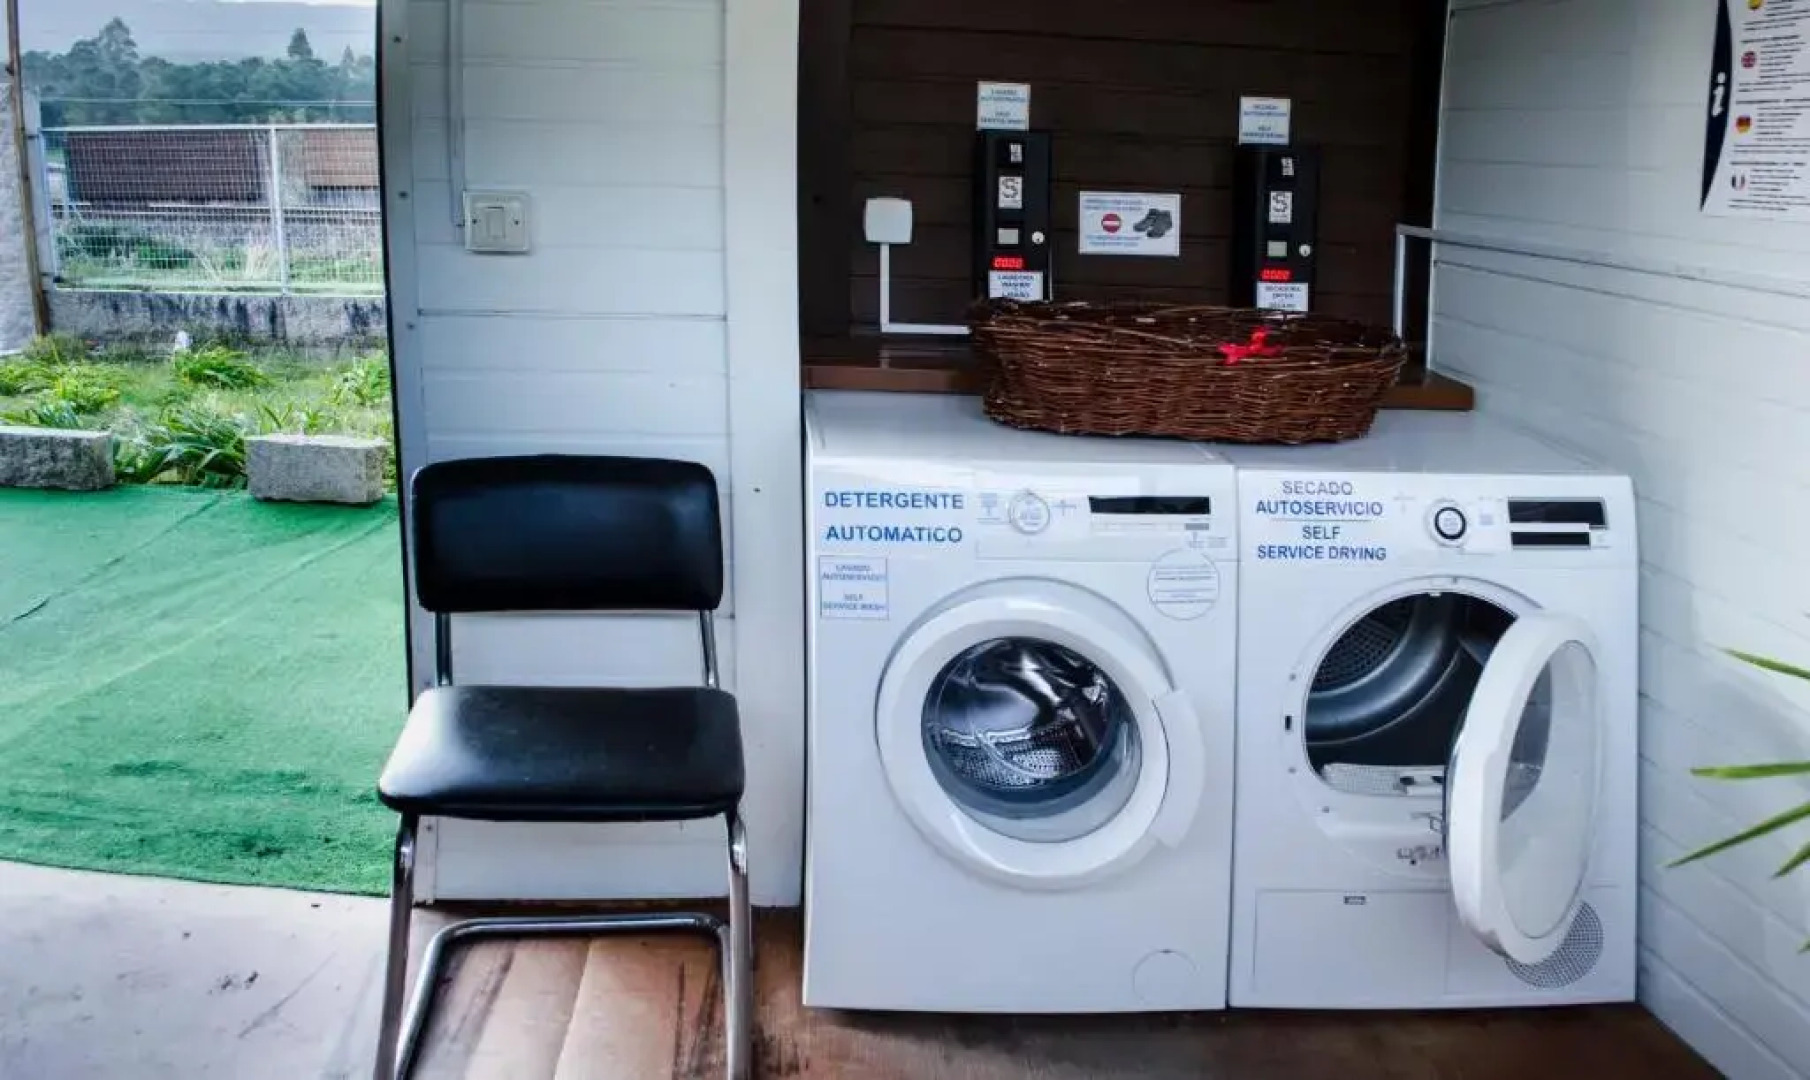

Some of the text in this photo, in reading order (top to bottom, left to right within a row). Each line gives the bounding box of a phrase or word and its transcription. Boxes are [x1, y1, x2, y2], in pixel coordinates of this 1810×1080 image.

[1282, 481, 1353, 496] SECADO
[824, 491, 964, 509] DETERGENTE
[1256, 500, 1383, 516] AUTOSERVICIO
[1302, 525, 1341, 540] SELF
[1257, 545, 1387, 561] SERVICE DRYING
